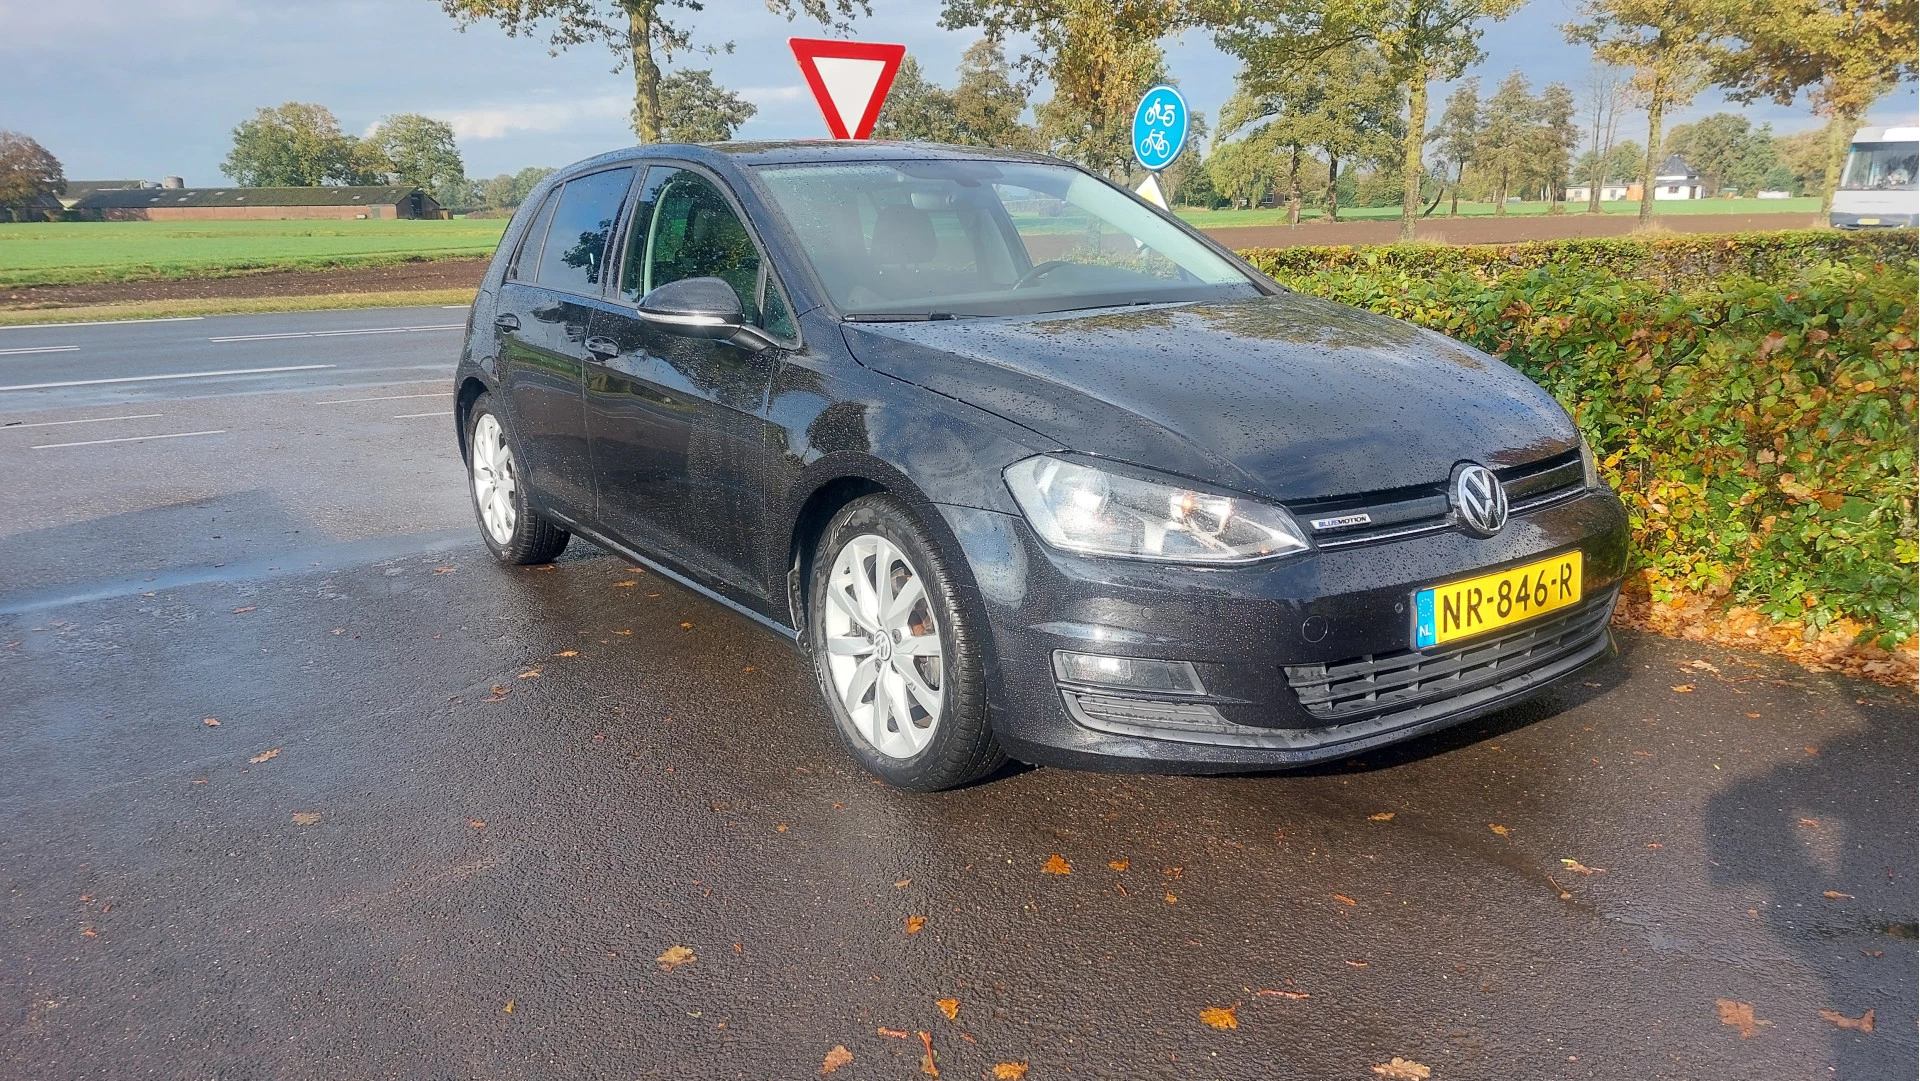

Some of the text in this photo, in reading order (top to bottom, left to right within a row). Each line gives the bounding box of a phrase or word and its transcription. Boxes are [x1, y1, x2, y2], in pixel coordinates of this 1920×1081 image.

[1318, 515, 1367, 527] BLUEMOTION
[1443, 562, 1572, 633] NR-846-R
[1419, 624, 1432, 637] NL
